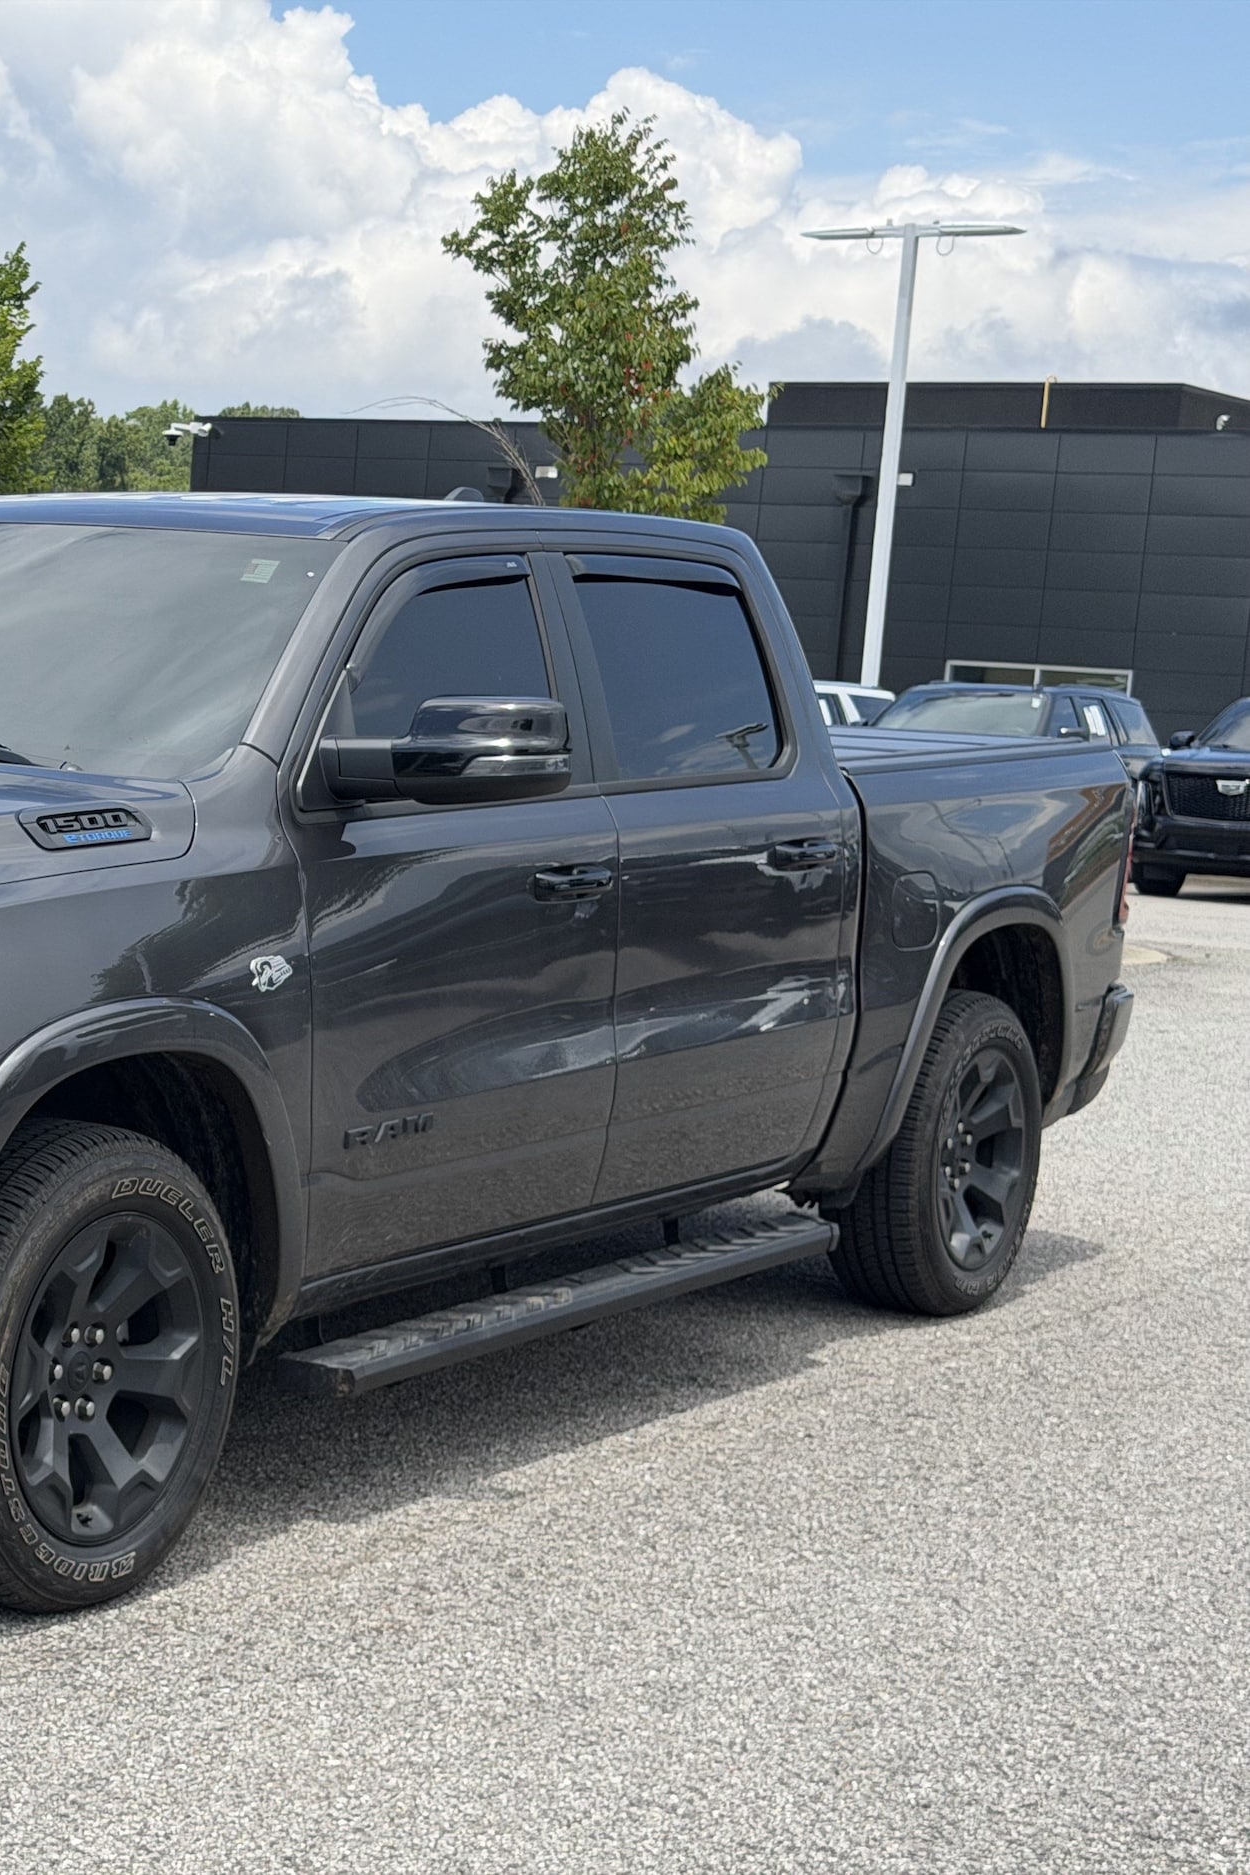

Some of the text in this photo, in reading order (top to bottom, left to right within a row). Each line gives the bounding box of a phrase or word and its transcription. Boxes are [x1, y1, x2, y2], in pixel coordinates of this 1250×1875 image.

[40, 811, 128, 834] 1500
[343, 1112, 434, 1155] RAM
[111, 1177, 235, 1386] DUELER H/L
